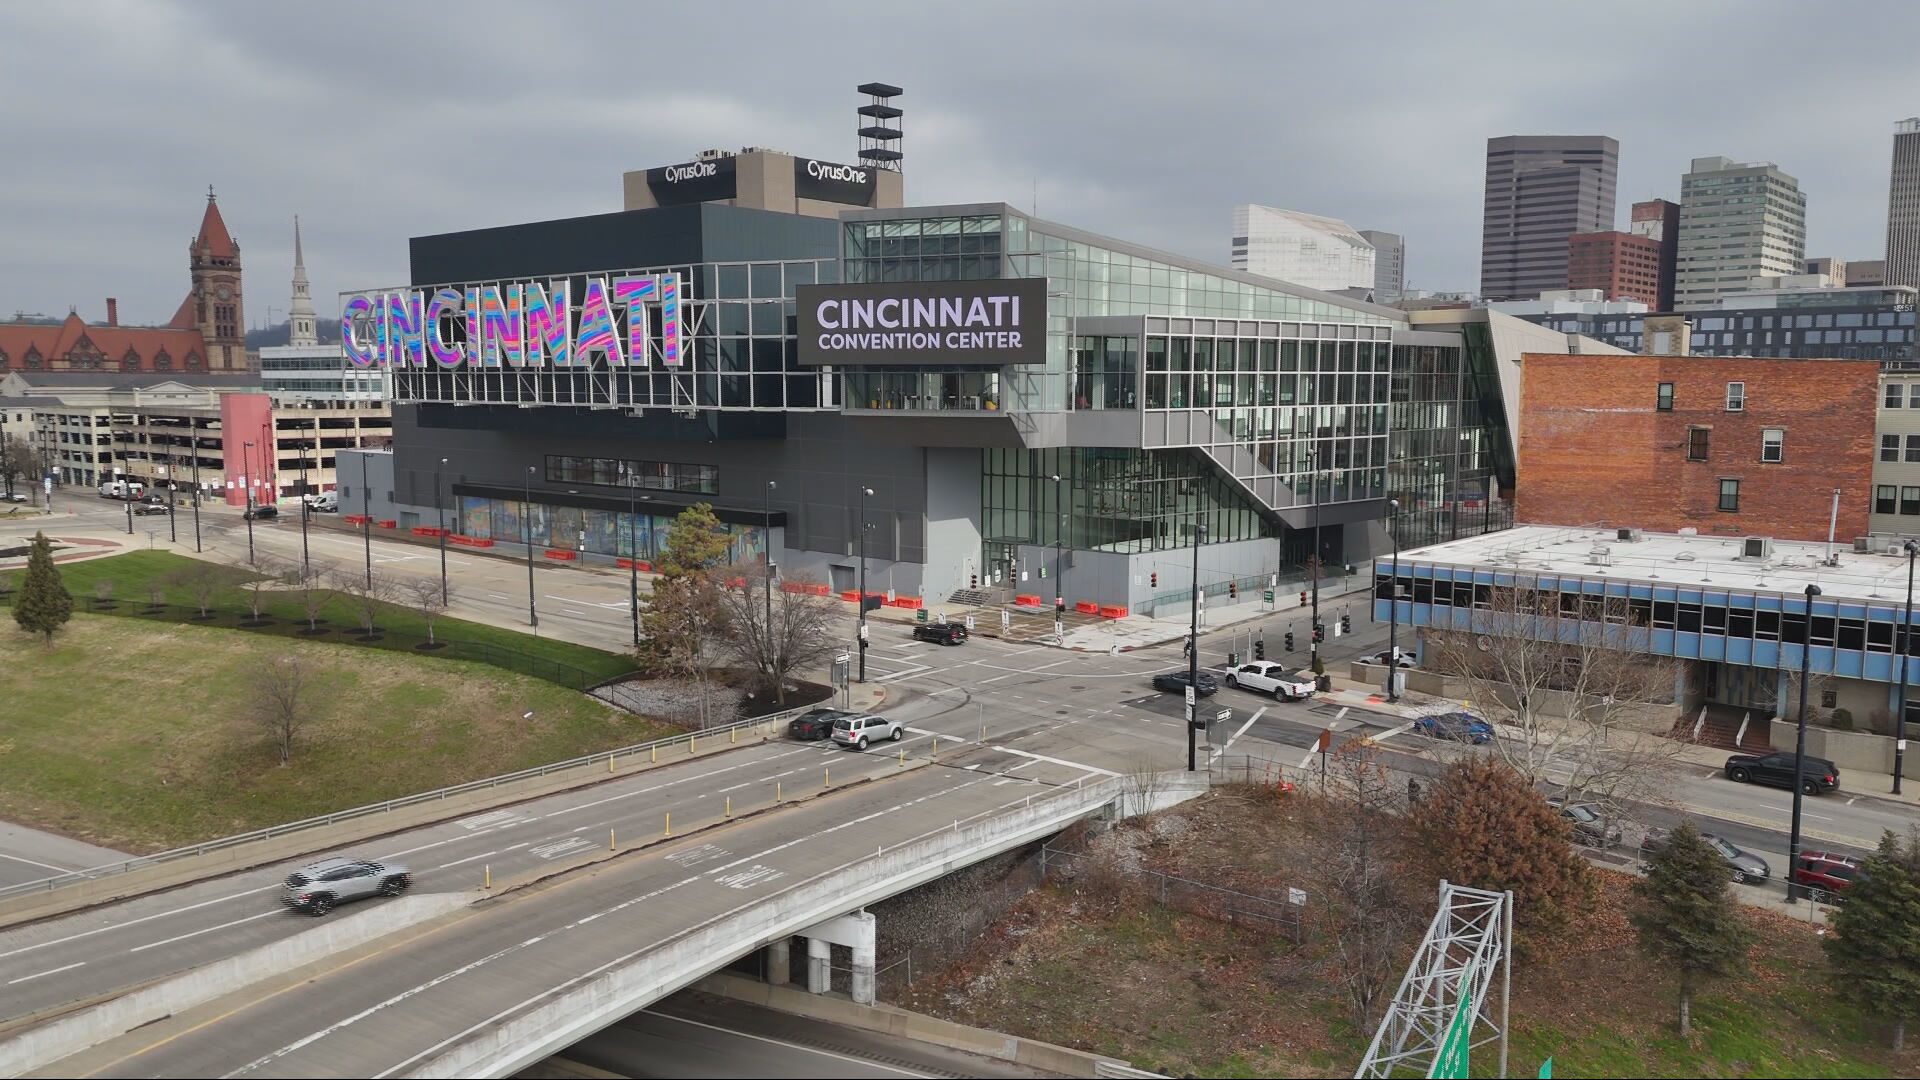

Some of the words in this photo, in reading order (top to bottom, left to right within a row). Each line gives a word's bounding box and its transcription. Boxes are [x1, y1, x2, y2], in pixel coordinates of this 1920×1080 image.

[665, 161, 717, 184] CyrusOne
[807, 160, 867, 184] CyrusOne
[341, 271, 683, 369] CINCINNATI
[816, 295, 1020, 329] CINCINNATI
[818, 332, 941, 350] CONVENTION
[945, 331, 1023, 349] CENTER
